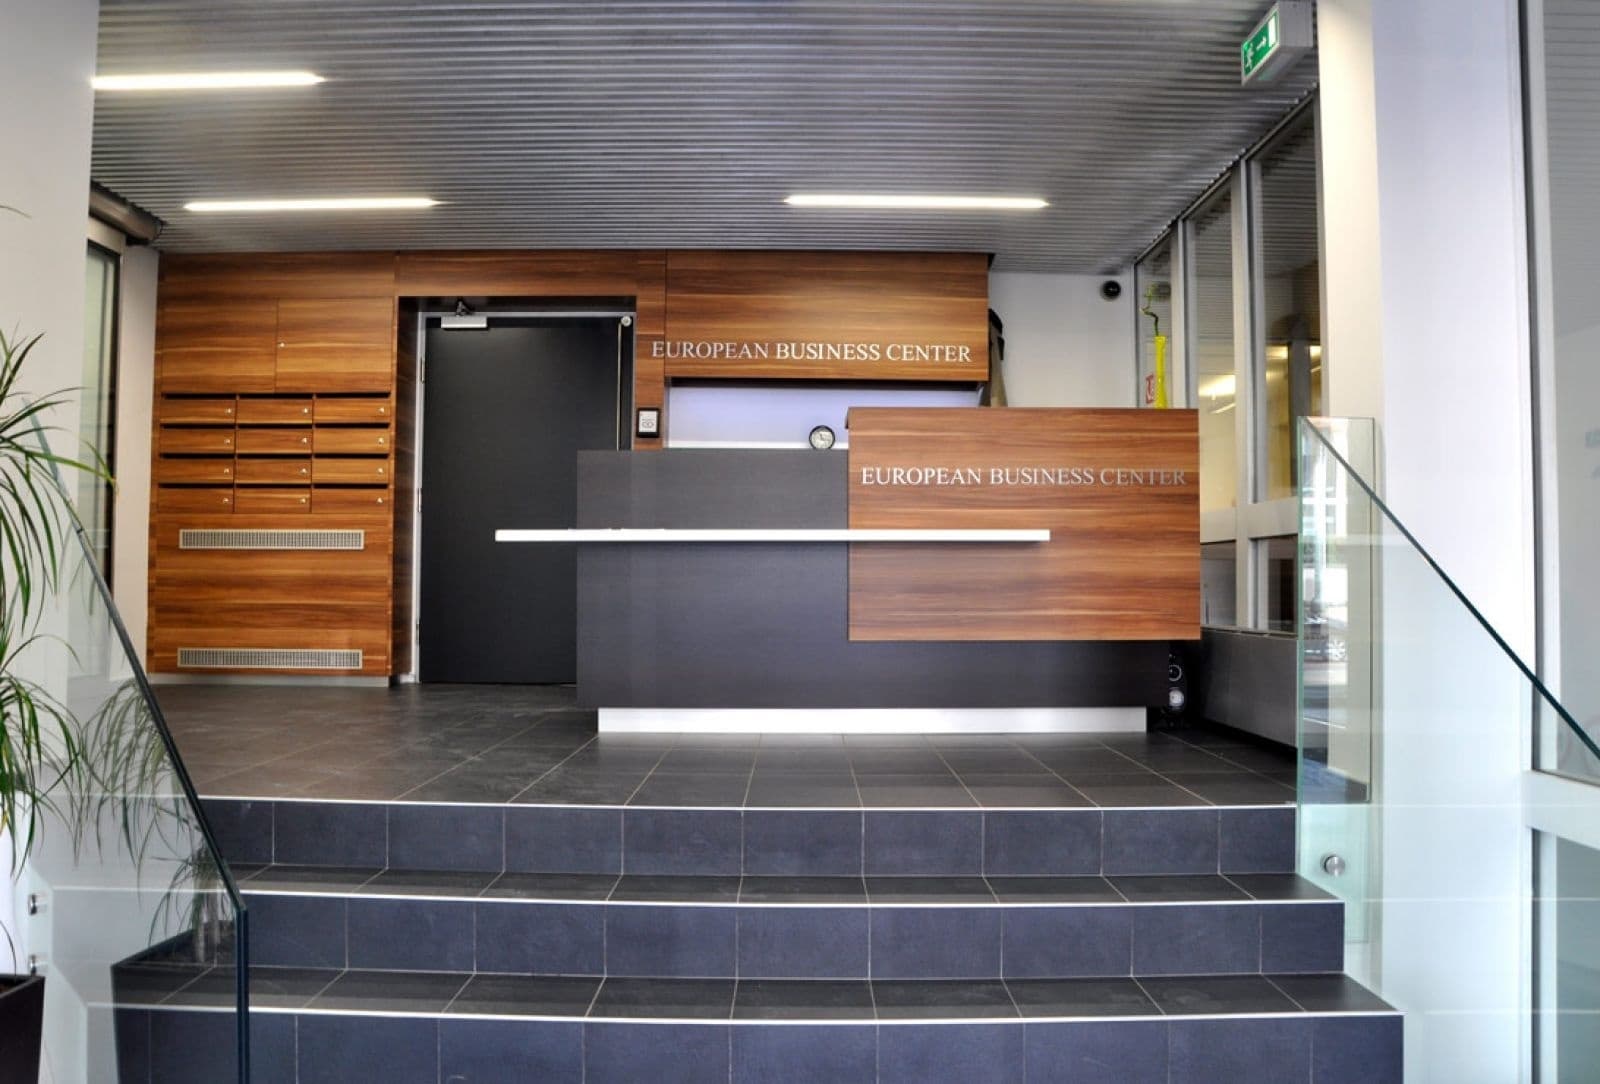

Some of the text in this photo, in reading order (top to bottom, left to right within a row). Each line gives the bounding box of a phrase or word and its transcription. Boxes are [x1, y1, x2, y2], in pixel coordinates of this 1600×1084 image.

[652, 341, 972, 363] EUROPEAN BUSINESS CENTER
[861, 466, 1186, 486] EUROPEAN BUSINESS CENTER
